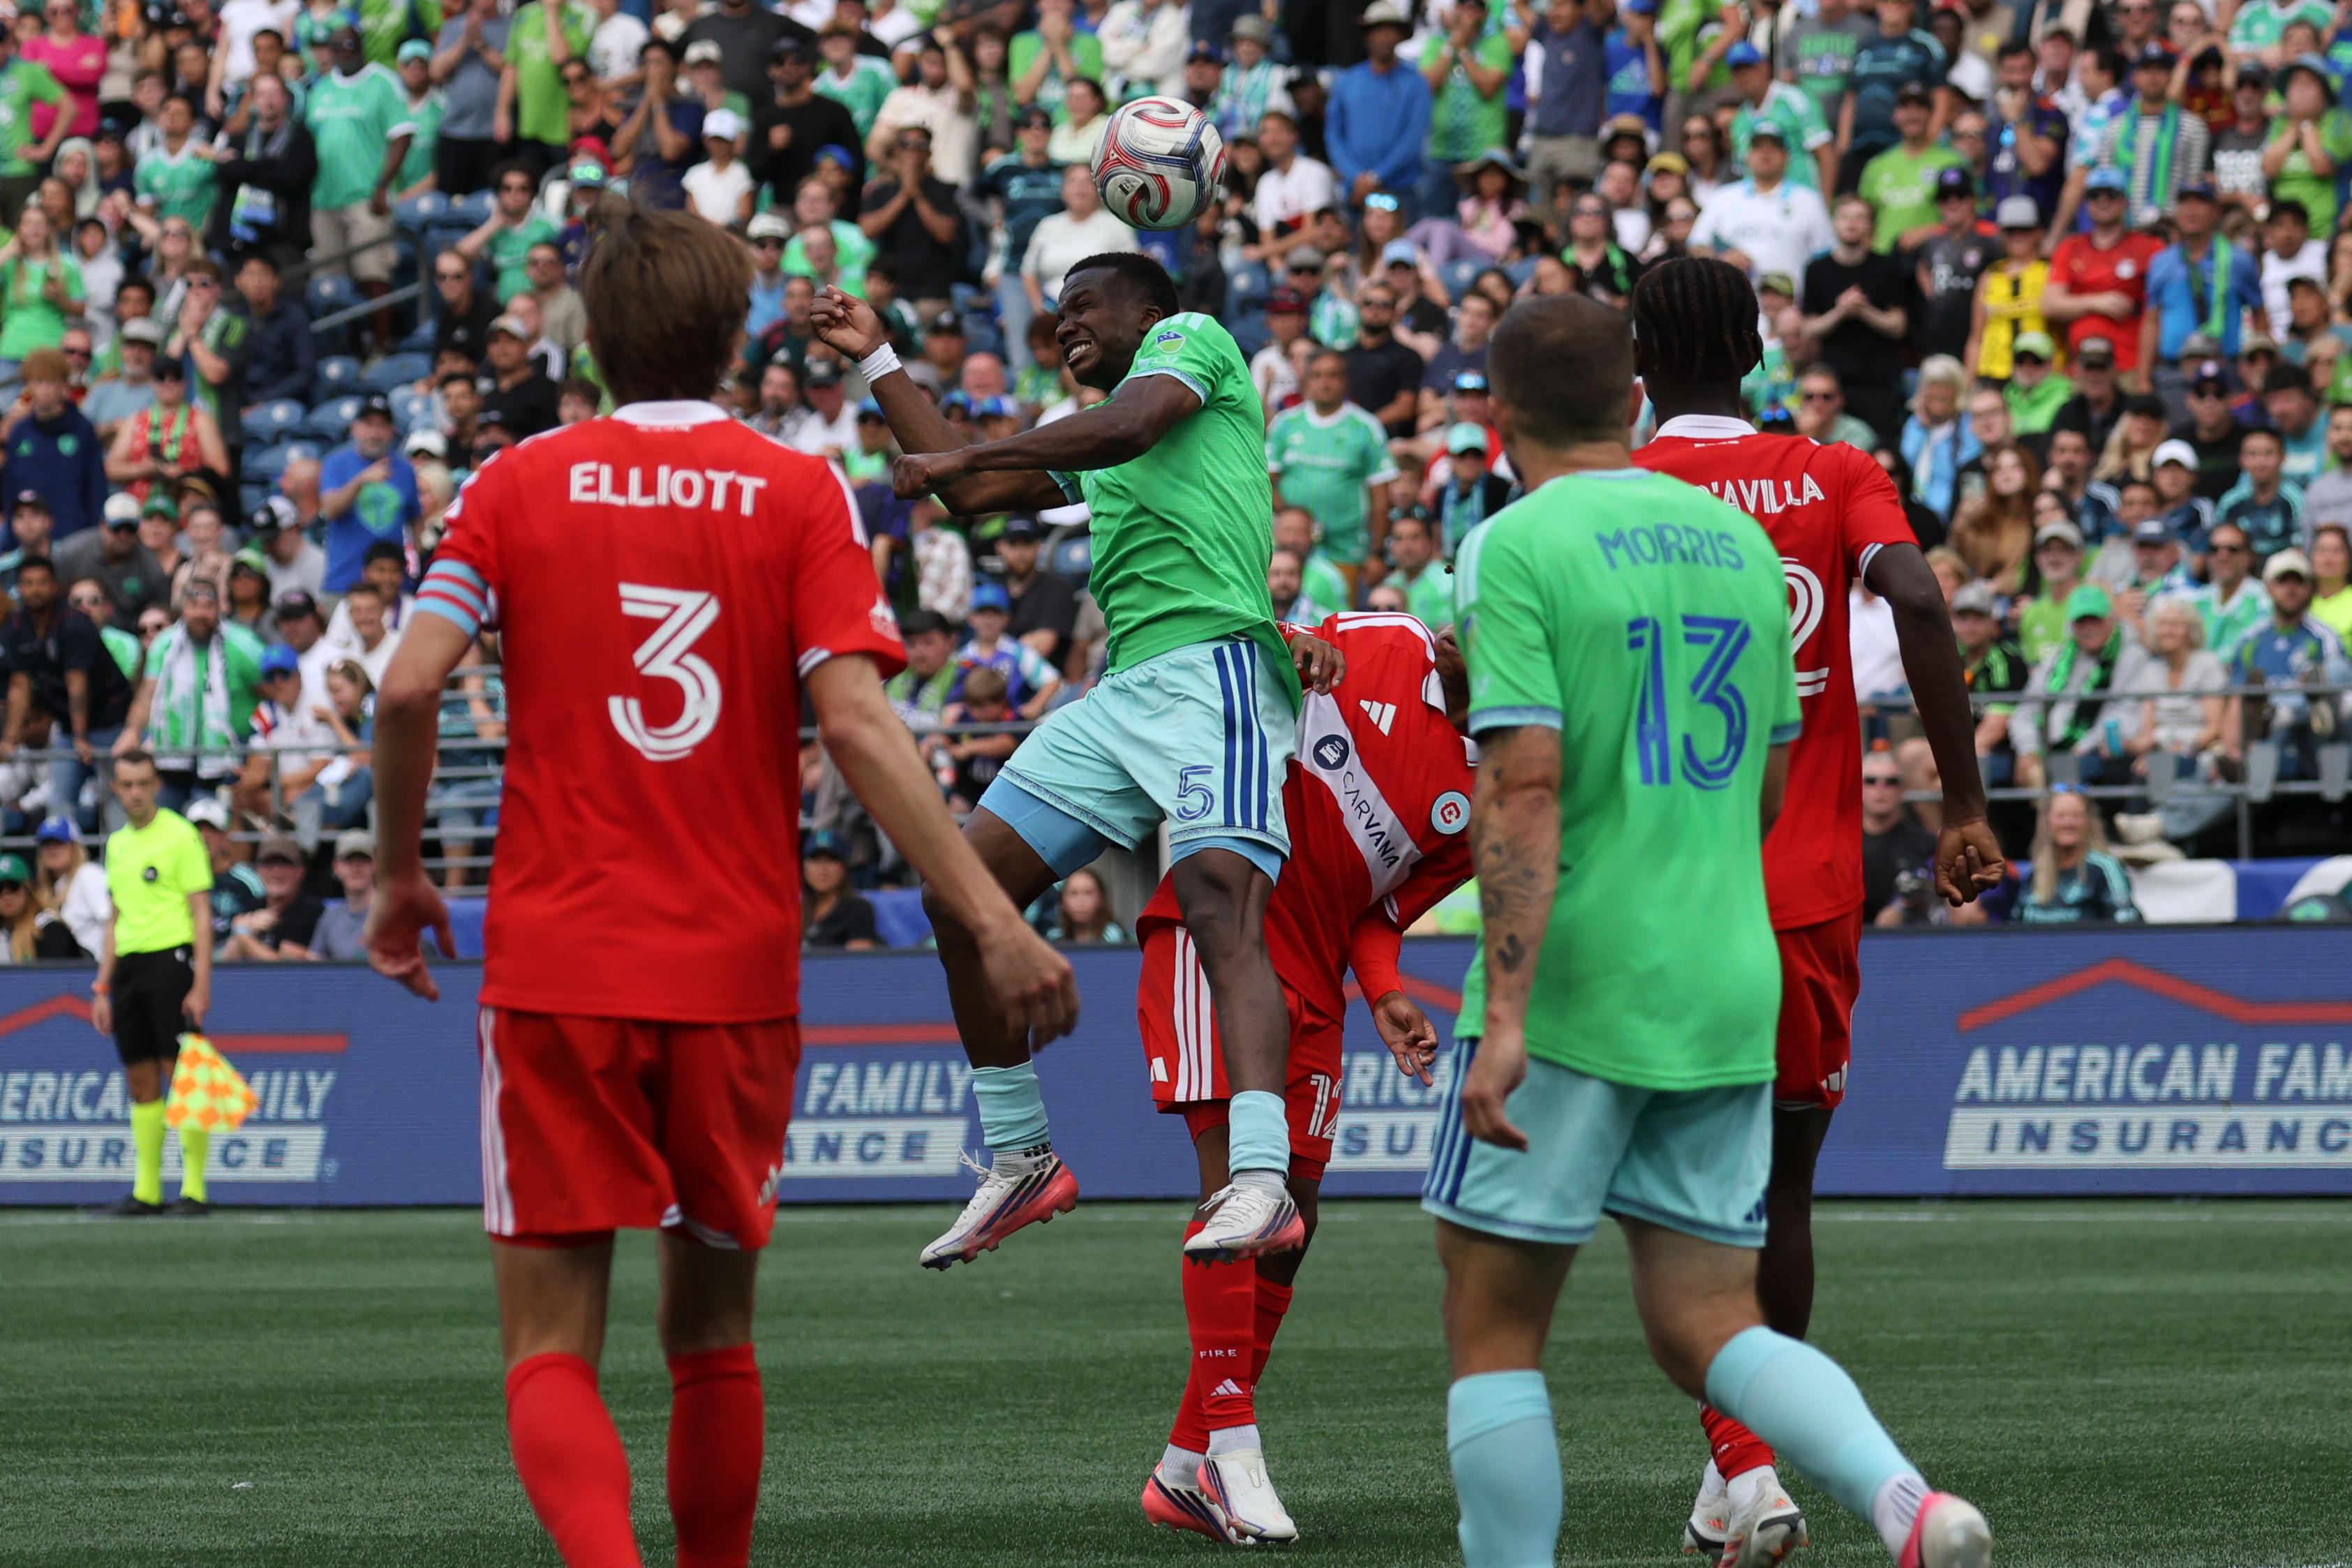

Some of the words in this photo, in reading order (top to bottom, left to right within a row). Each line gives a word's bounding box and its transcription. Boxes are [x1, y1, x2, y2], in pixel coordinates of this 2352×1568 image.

[570, 461, 767, 516] ELLIOTT
[1595, 523, 1744, 571] MORRIS
[608, 581, 722, 762] 3
[1627, 613, 1752, 791] 13
[1177, 765, 1214, 820] 5
[1343, 771, 1400, 869] CARVANA
[0, 1070, 133, 1121] ERICA
[804, 1061, 972, 1114] FAMILY
[1955, 1044, 2240, 1101] AMERICAN
[1200, 1349, 1237, 1359] FIRE
